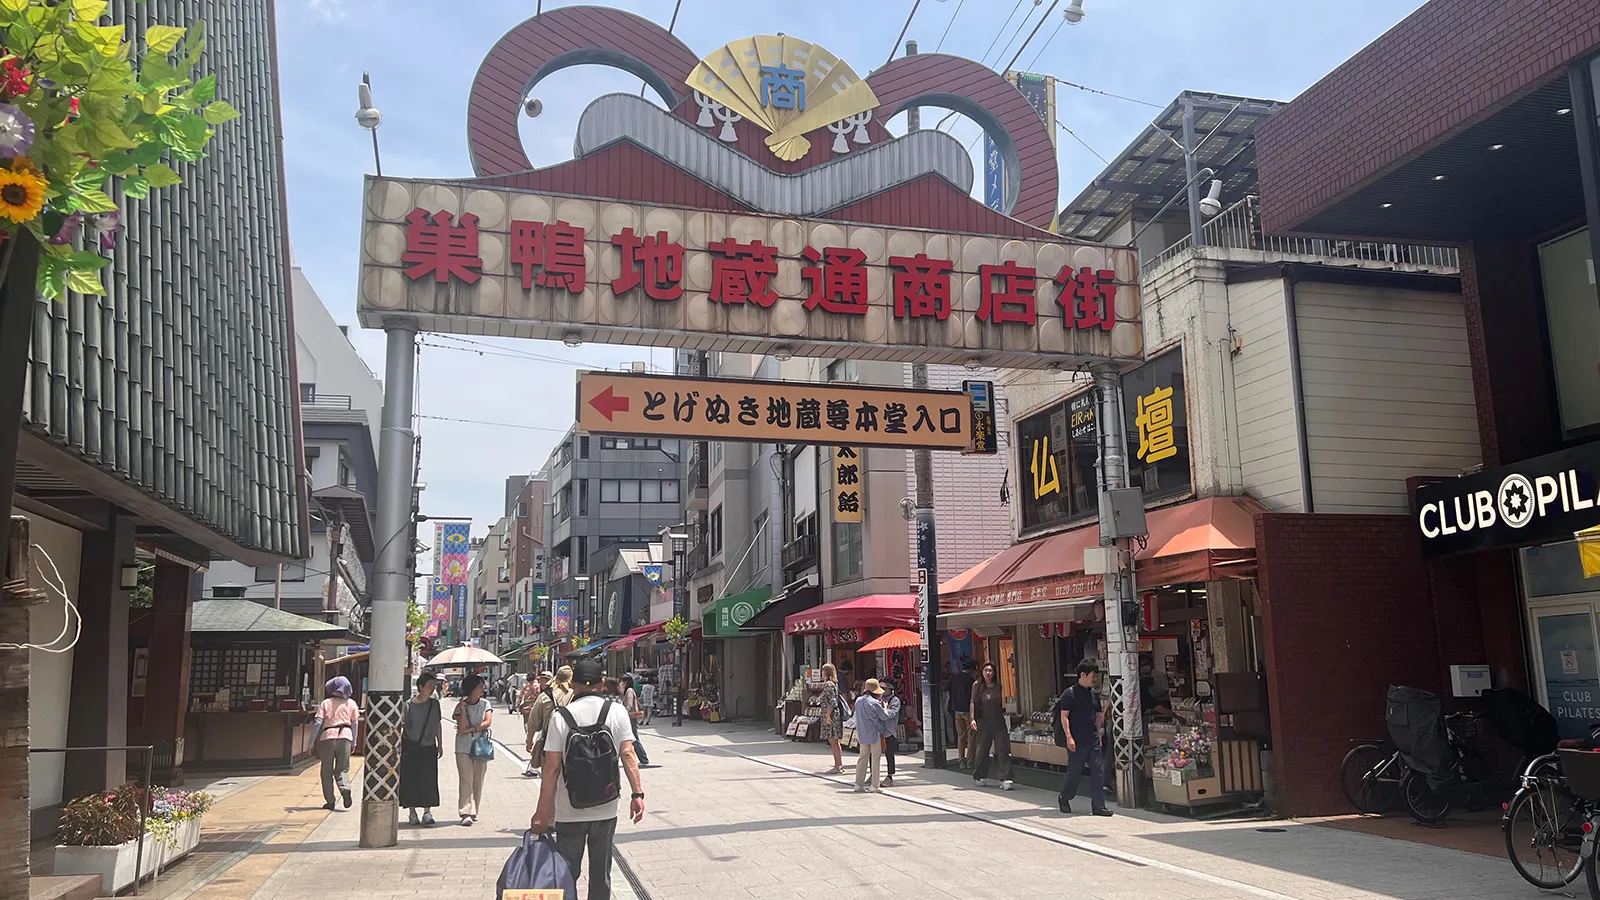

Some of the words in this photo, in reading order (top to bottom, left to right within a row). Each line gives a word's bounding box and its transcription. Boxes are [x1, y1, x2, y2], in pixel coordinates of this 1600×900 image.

[760, 63, 806, 111] 商
[402, 208, 1118, 331] 巣鴨地蔵通商店街
[642, 388, 962, 435] とげぬき地蔵尊本堂入口
[1030, 434, 1060, 500] 仏
[1135, 386, 1178, 464] 壇
[1419, 490, 1497, 539] CLUB
[1535, 469, 1600, 517] PIL
[1557, 706, 1600, 719] PILATES
[1563, 691, 1592, 702] CLUB
